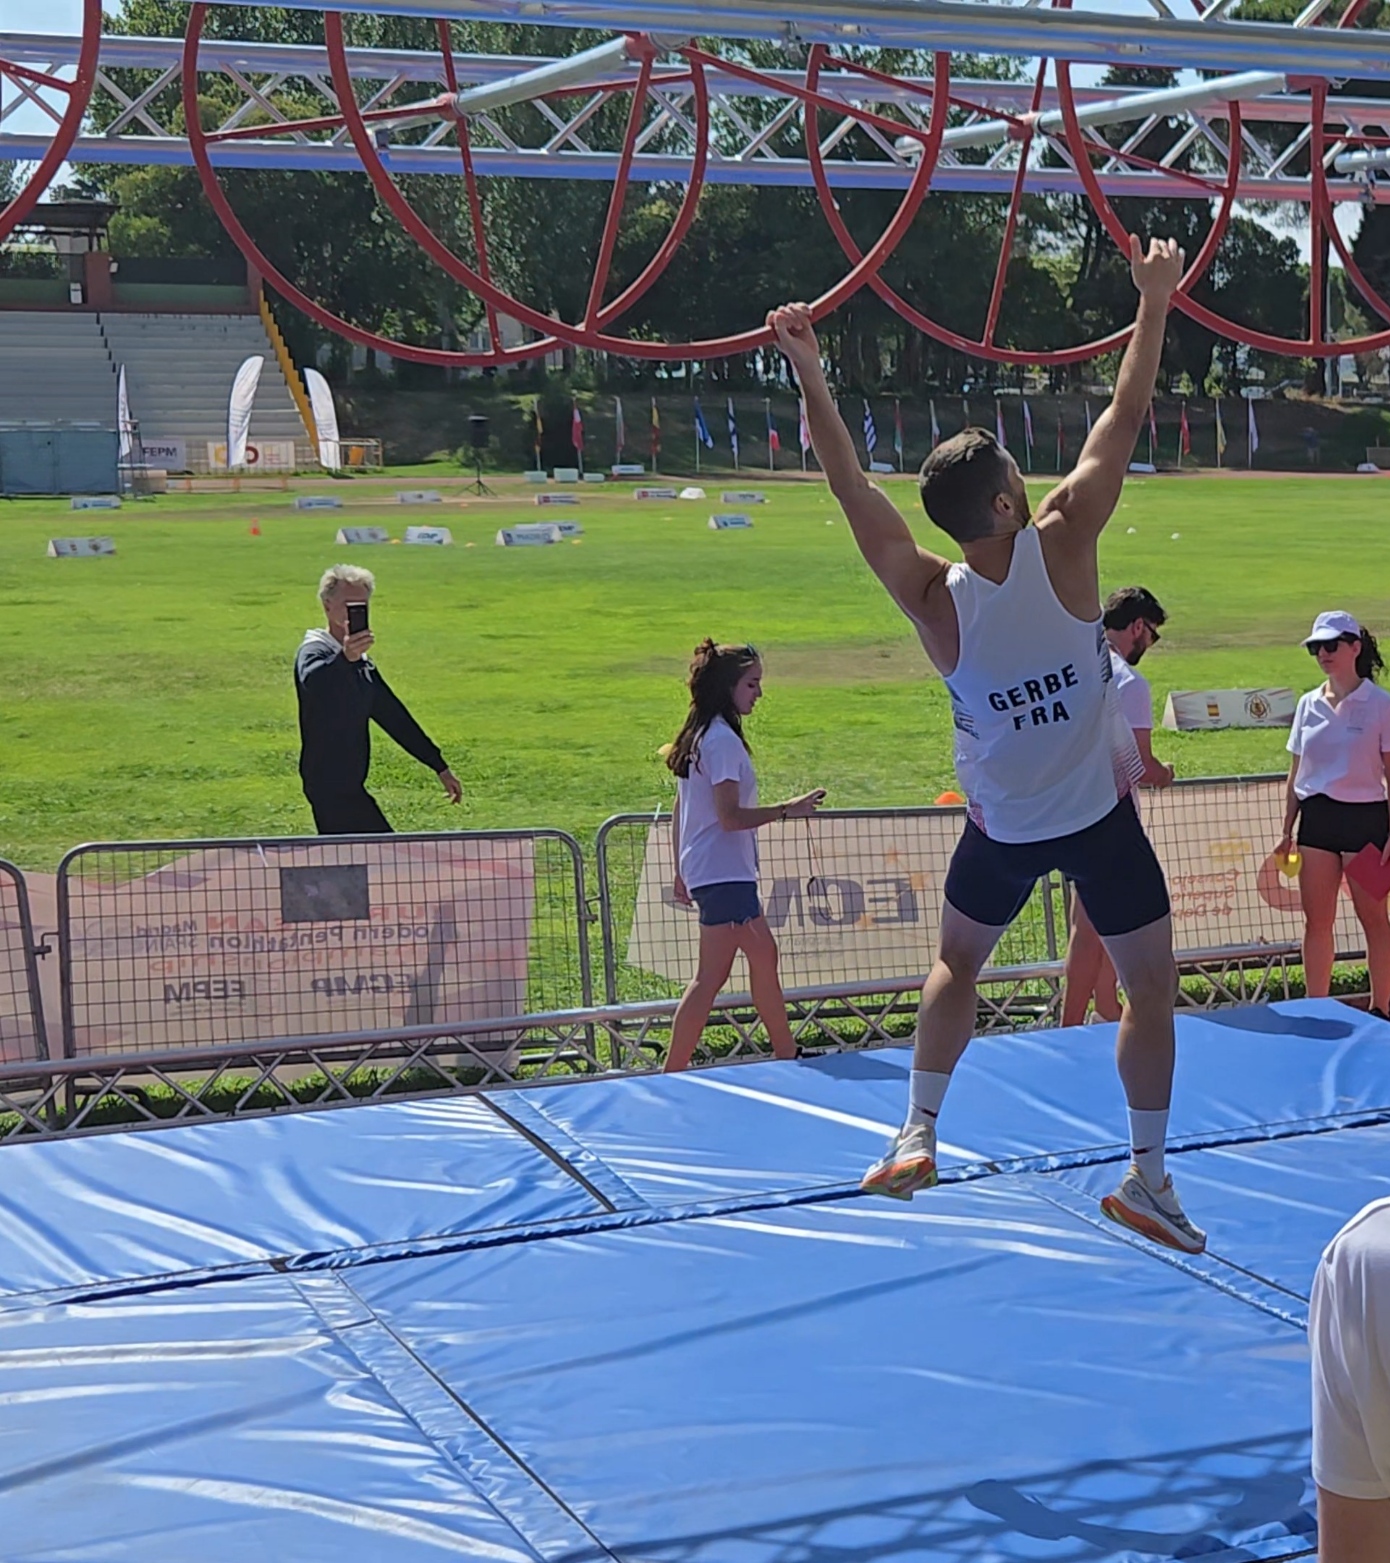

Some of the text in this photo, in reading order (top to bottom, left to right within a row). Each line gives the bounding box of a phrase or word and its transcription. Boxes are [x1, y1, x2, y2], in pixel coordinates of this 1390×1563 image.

[142, 446, 177, 458] FEPM
[988, 663, 1079, 712] GERBE
[1013, 700, 1070, 731] FRA
